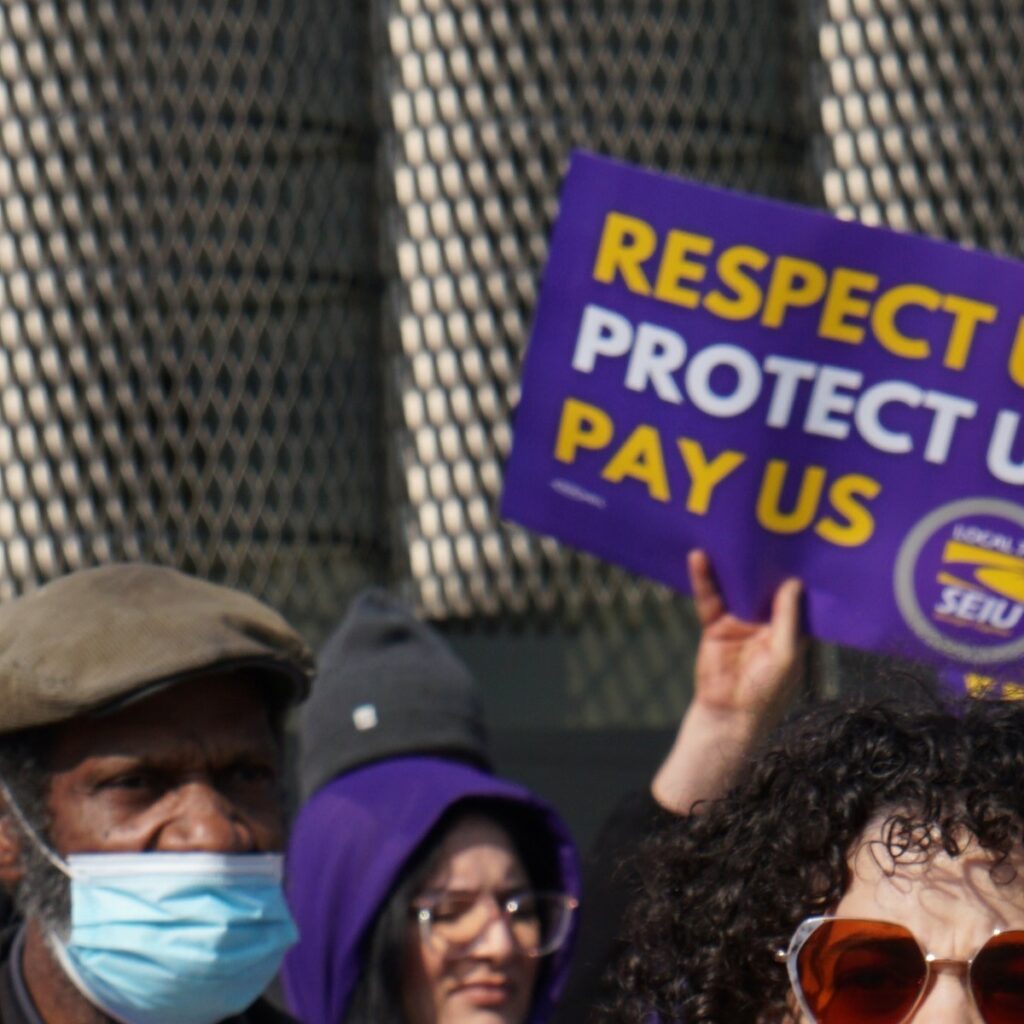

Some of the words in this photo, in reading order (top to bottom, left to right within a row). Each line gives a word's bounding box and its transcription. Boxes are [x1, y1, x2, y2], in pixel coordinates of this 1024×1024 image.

[593, 212, 997, 371] RESPECT
[572, 304, 978, 464] PROTECT
[554, 397, 745, 515] PAY
[755, 459, 881, 547] US
[952, 524, 1014, 554] LOCAL
